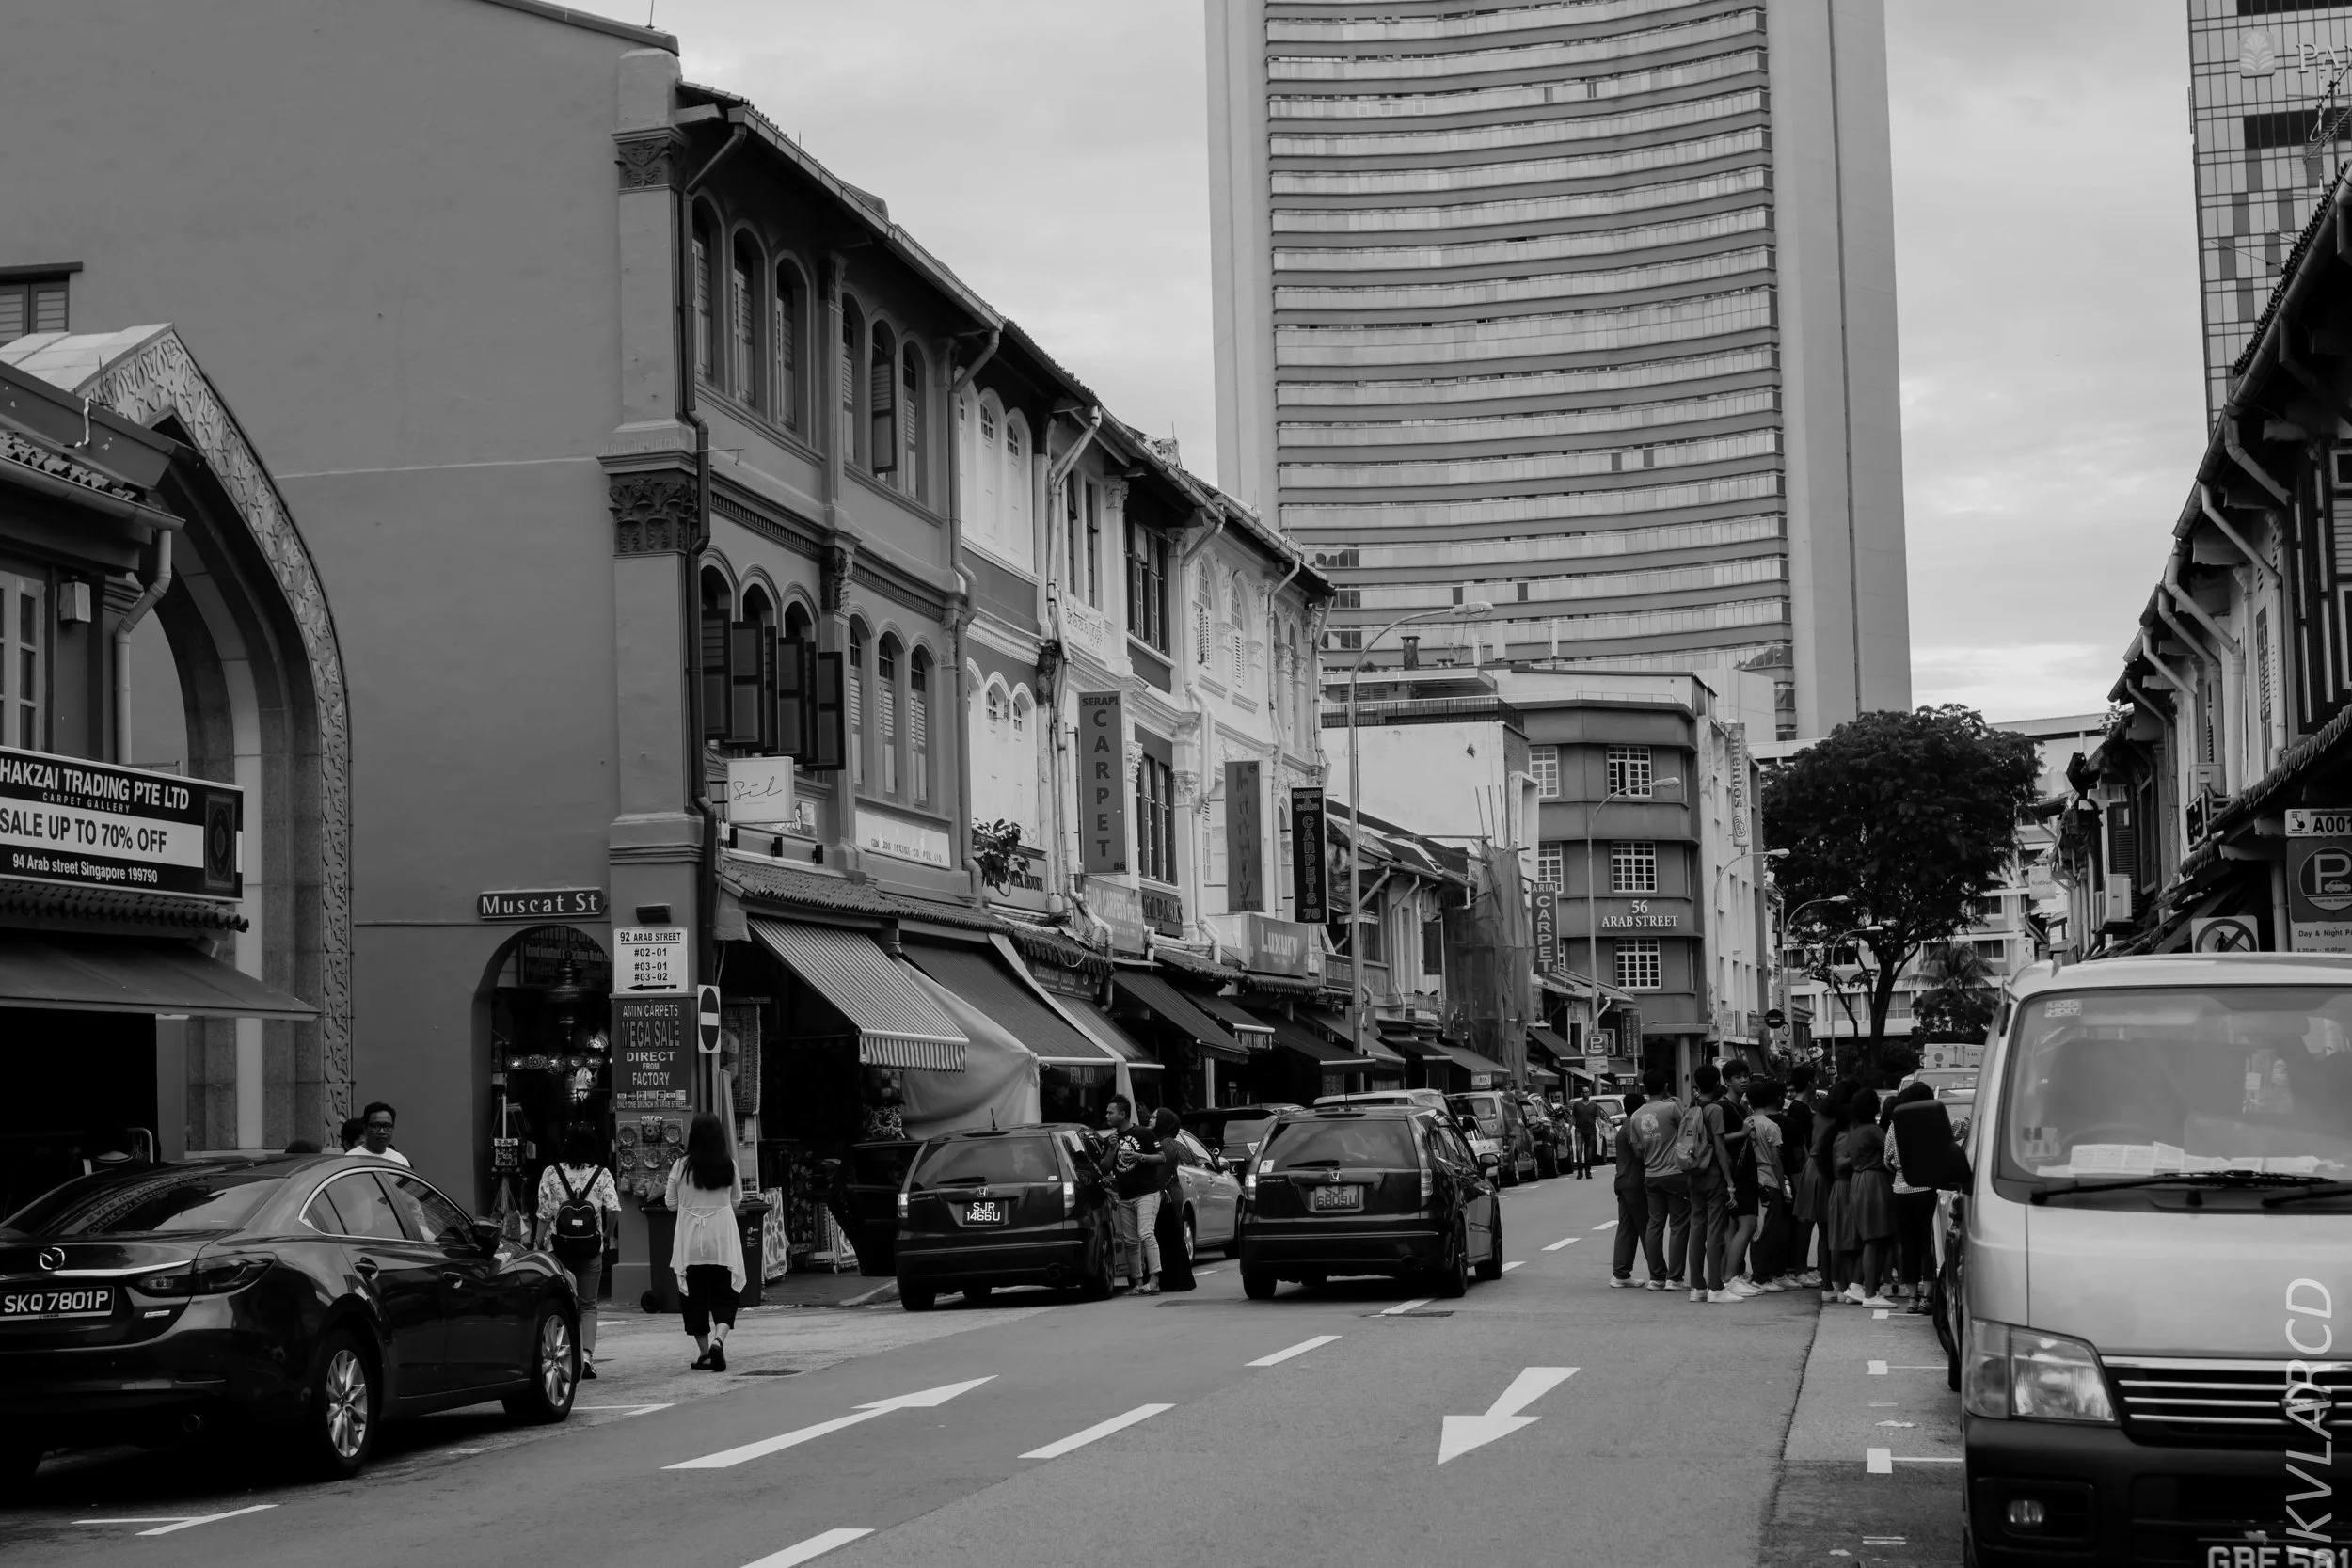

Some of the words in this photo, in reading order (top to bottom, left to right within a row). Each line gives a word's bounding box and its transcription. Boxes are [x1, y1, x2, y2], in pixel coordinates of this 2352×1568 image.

[1082, 696, 1120, 707] SERAPI
[1731, 737, 1743, 808] mentos
[63, 768, 129, 801] TRADING
[134, 783, 160, 806] PTE
[165, 786, 190, 810] LTD
[1092, 707, 1111, 860] CARPET
[42, 792, 81, 806] CARPET
[87, 799, 130, 814] GALLERY
[0, 808, 43, 838] SALE
[48, 815, 70, 841] UP
[75, 819, 97, 845] TO
[102, 823, 133, 850] 70%
[137, 827, 167, 853] OFF
[1114, 861, 1126, 871] 86
[1302, 815, 1318, 906] CARPETS
[12, 853, 24, 868] 94
[27, 855, 49, 872] Arab
[52, 858, 79, 875] street
[81, 862, 126, 883] Singapore
[128, 866, 158, 884] 199790
[1532, 884, 1555, 893] ARIA
[482, 895, 564, 914] Muscat
[575, 893, 598, 911] St
[1631, 900, 1648, 913] 56
[1303, 908, 1321, 920] 78
[1601, 915, 1633, 927] ARAB
[1635, 914, 1678, 927] STREET
[620, 932, 630, 942] 92
[633, 933, 653, 942] ARAB
[655, 932, 681, 942] STREET
[1536, 895, 1553, 973] CARPET
[2324, 929, 2343, 938] Night
[1260, 923, 1299, 964] Luxury
[634, 948, 667, 957] #02-01
[634, 962, 667, 971] #03-01
[634, 973, 668, 981] #03-02
[622, 1004, 642, 1018] AMIN
[644, 1004, 678, 1017] CARPETS
[621, 1021, 651, 1048] MEGA
[653, 1020, 680, 1047] SALE
[626, 1052, 675, 1062] DIRECT
[632, 1072, 670, 1085] FACTORY
[1325, 1186, 1347, 1196] SJF
[973, 1202, 995, 1212] SJR
[967, 1212, 1000, 1221] 1466U
